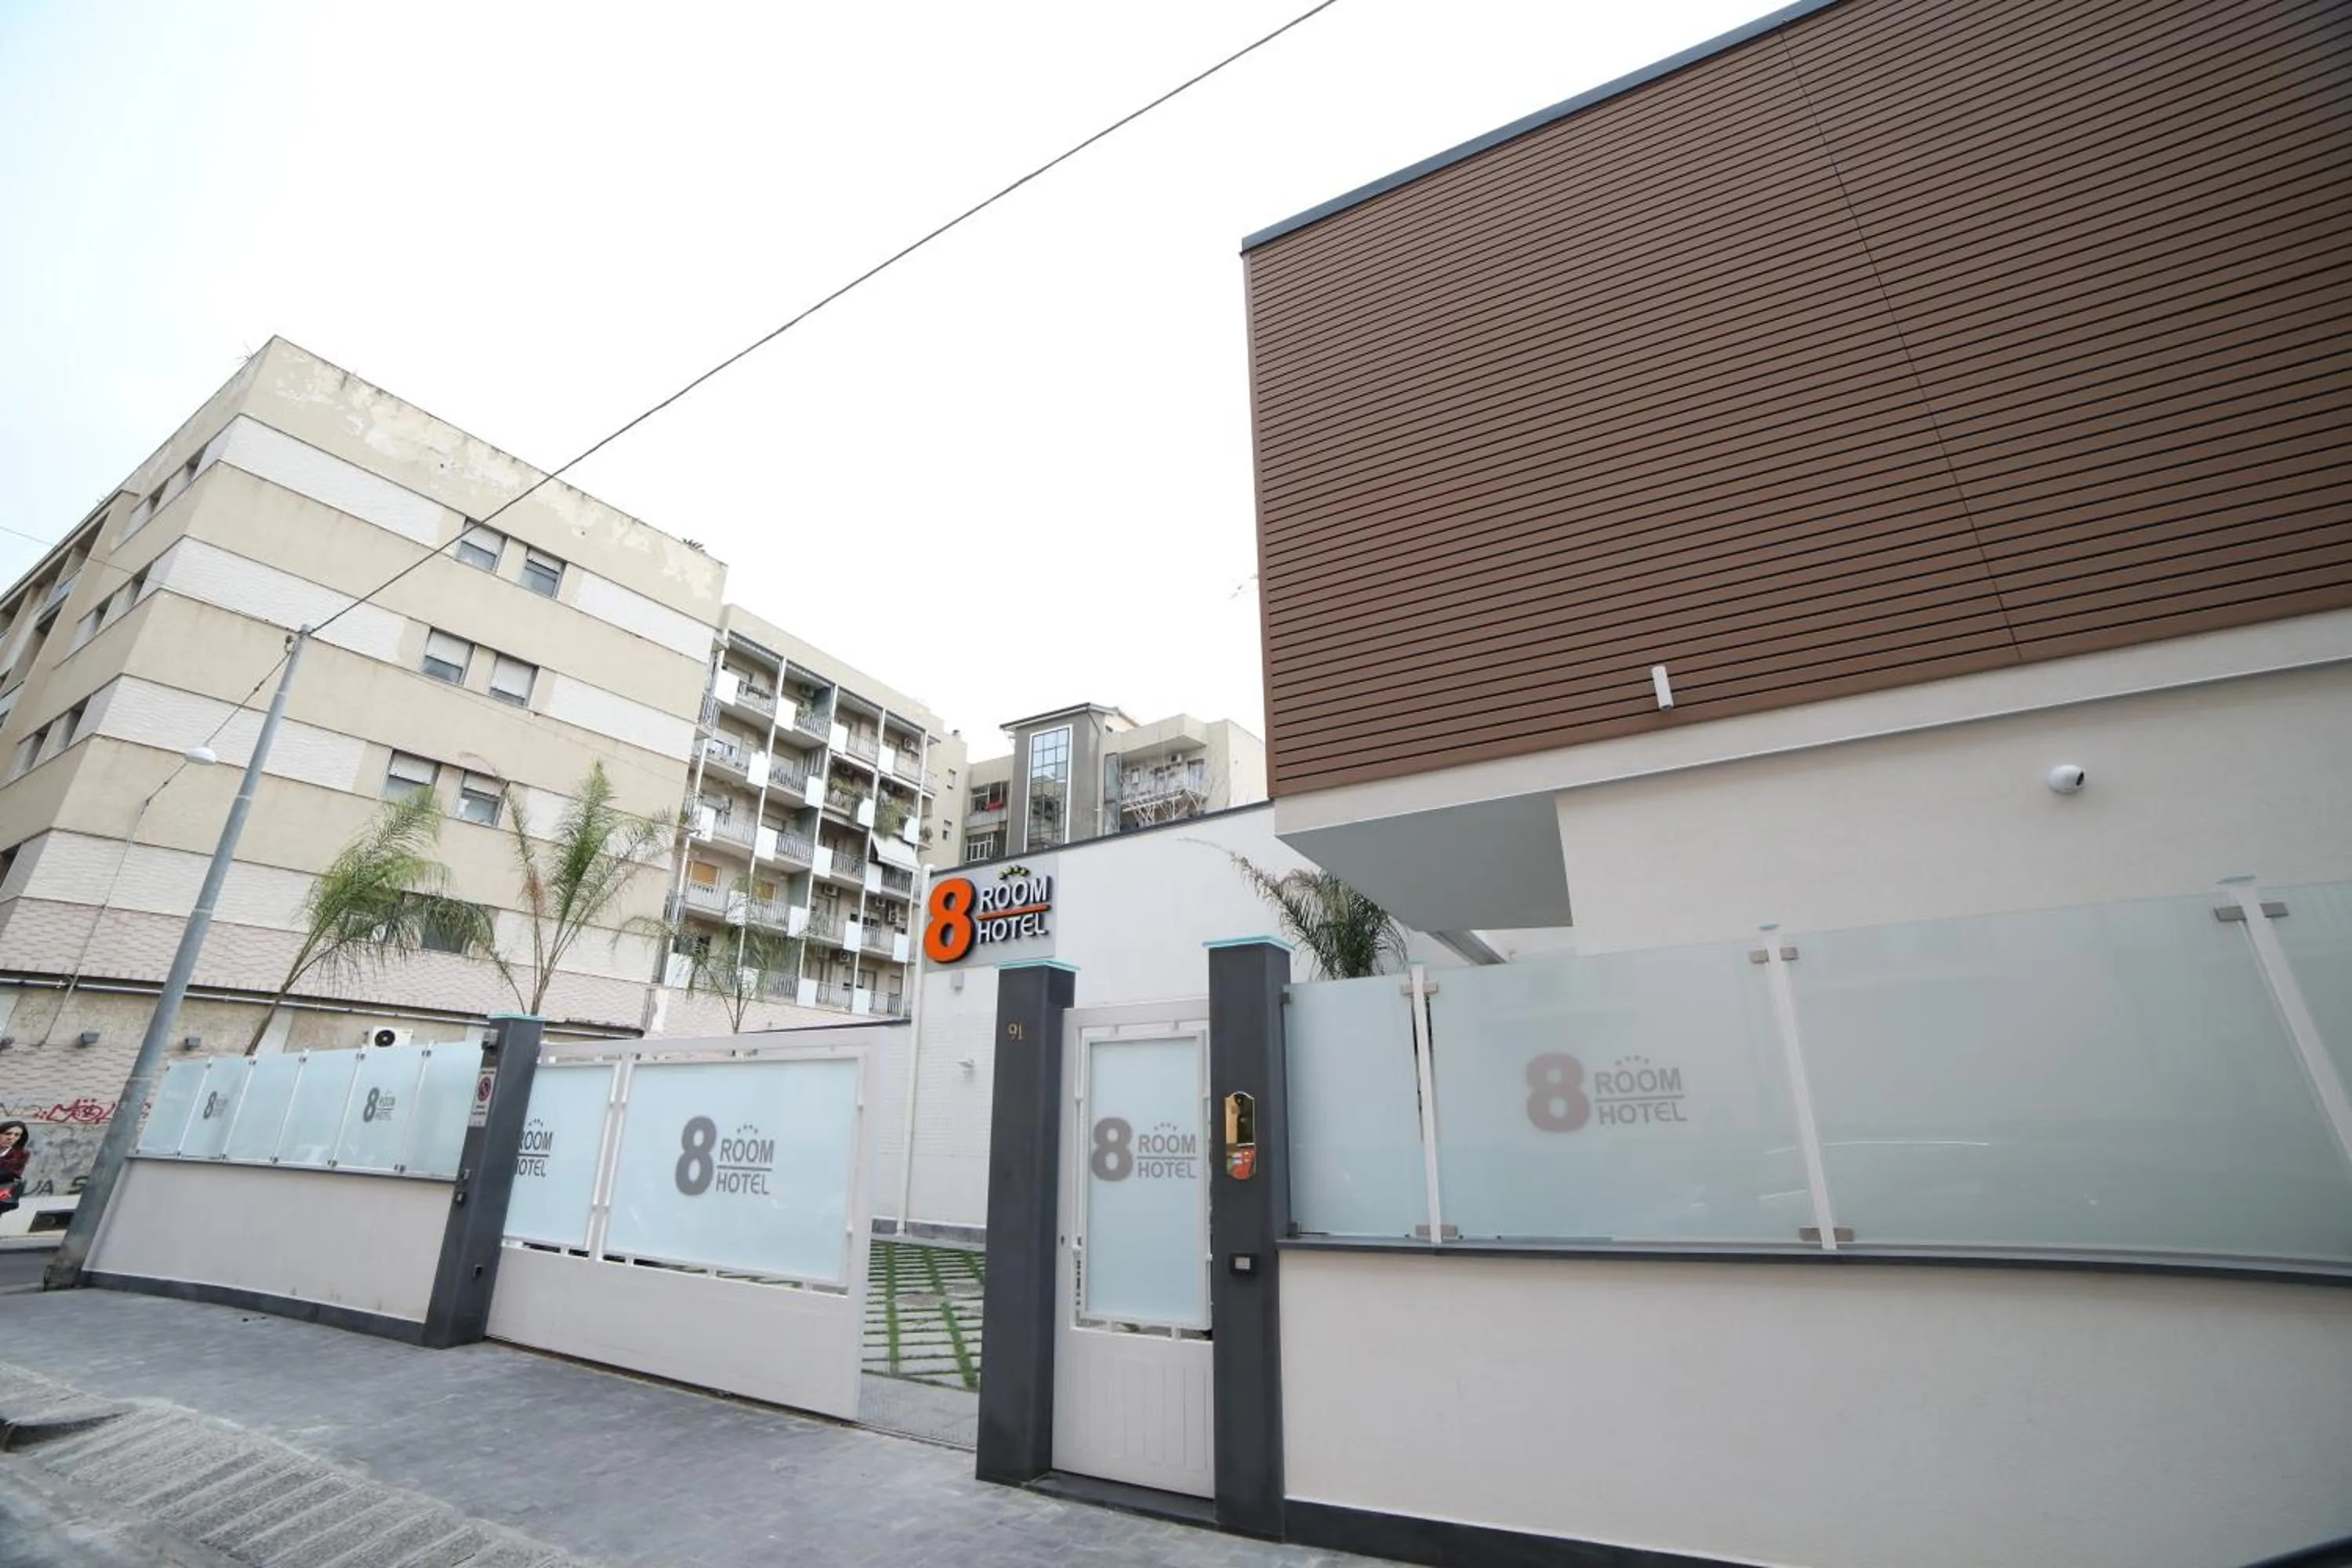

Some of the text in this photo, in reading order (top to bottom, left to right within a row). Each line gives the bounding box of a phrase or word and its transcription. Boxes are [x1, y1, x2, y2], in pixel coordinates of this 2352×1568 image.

[980, 875, 1052, 912] ROOM
[924, 877, 977, 964] 8
[978, 912, 1049, 944] HOTEL
[1008, 1022, 1022, 1040] 91
[1524, 1052, 1591, 1133] 8
[1595, 1067, 1682, 1094] ROOM
[203, 1091, 218, 1120] 8
[364, 1087, 380, 1123] 8
[1598, 1102, 1688, 1126] HOTEL
[520, 1131, 553, 1152] OOM
[720, 1138, 774, 1163] ROOM
[1091, 1117, 1134, 1181] 8
[1138, 1134, 1196, 1154] ROOM
[675, 1116, 717, 1196] 8
[1138, 1160, 1196, 1179] HOTEL
[716, 1171, 770, 1195] HOTEL
